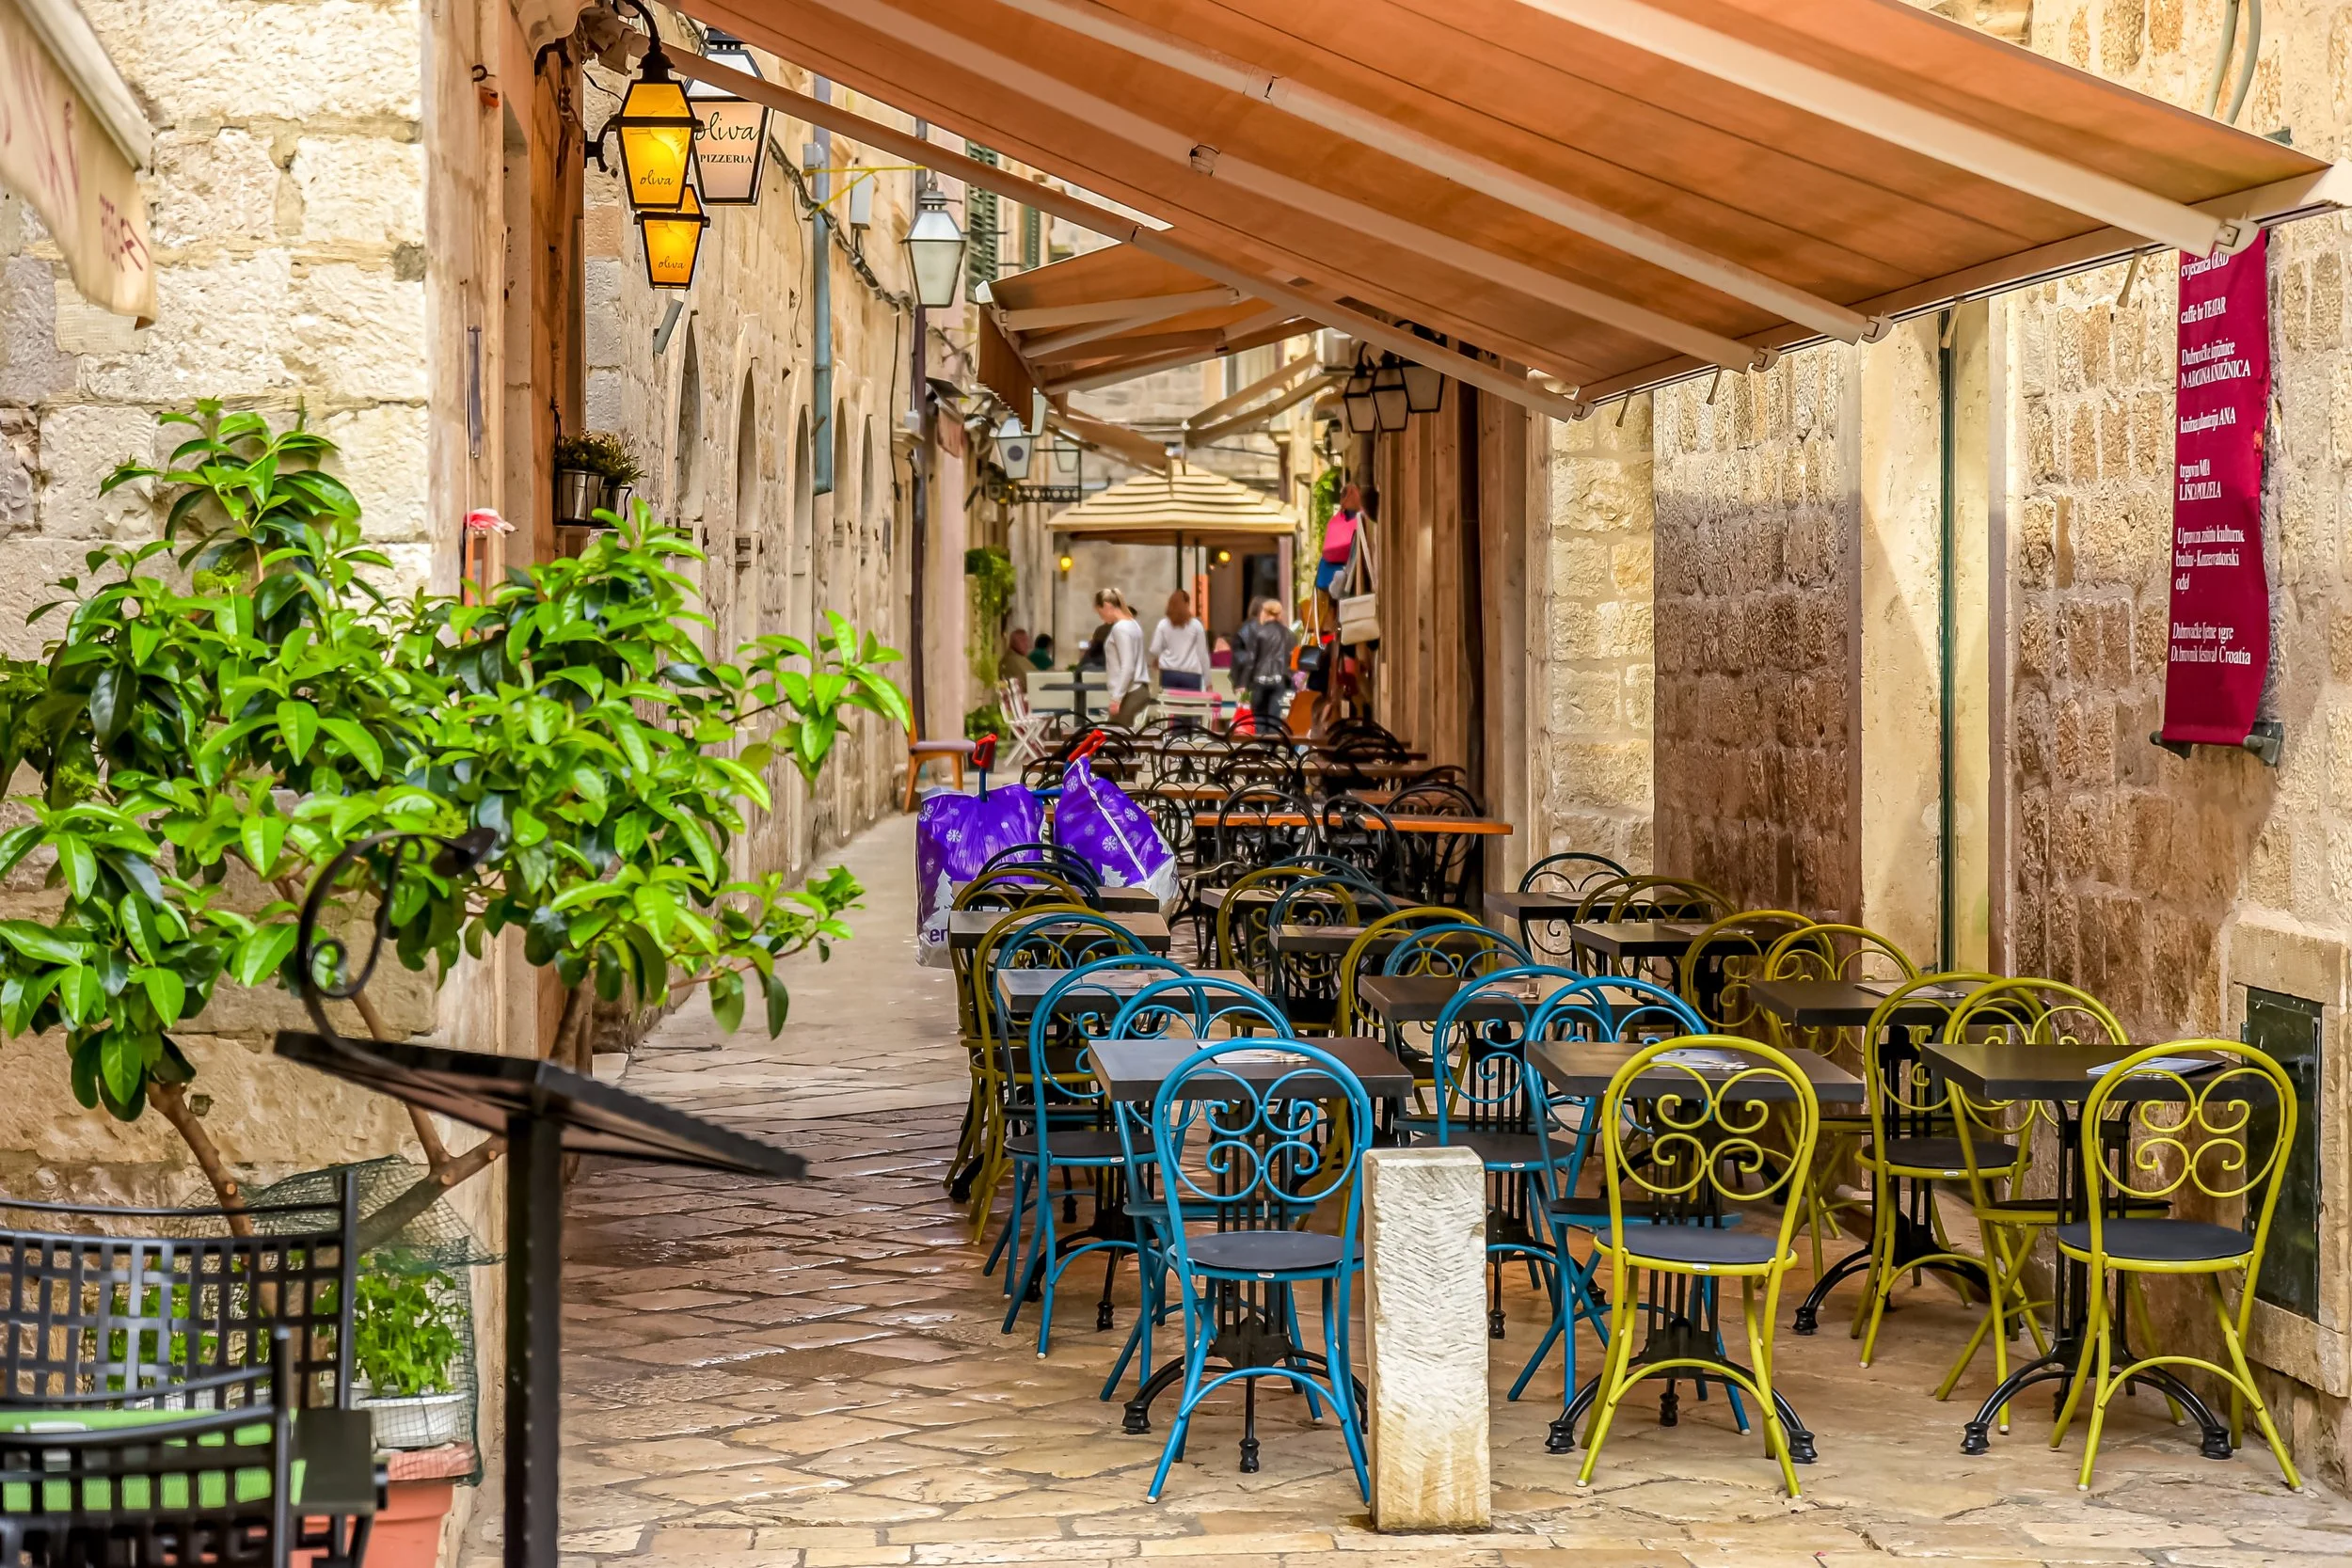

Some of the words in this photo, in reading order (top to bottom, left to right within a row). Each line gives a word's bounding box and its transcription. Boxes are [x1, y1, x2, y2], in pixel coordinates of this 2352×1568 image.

[699, 153, 754, 164] PIZZERIA
[639, 169, 674, 186] oliva
[658, 255, 685, 270] oliva
[2218, 406, 2236, 426] ANA
[2217, 622, 2234, 644] igre
[2218, 645, 2251, 665] Croatia
